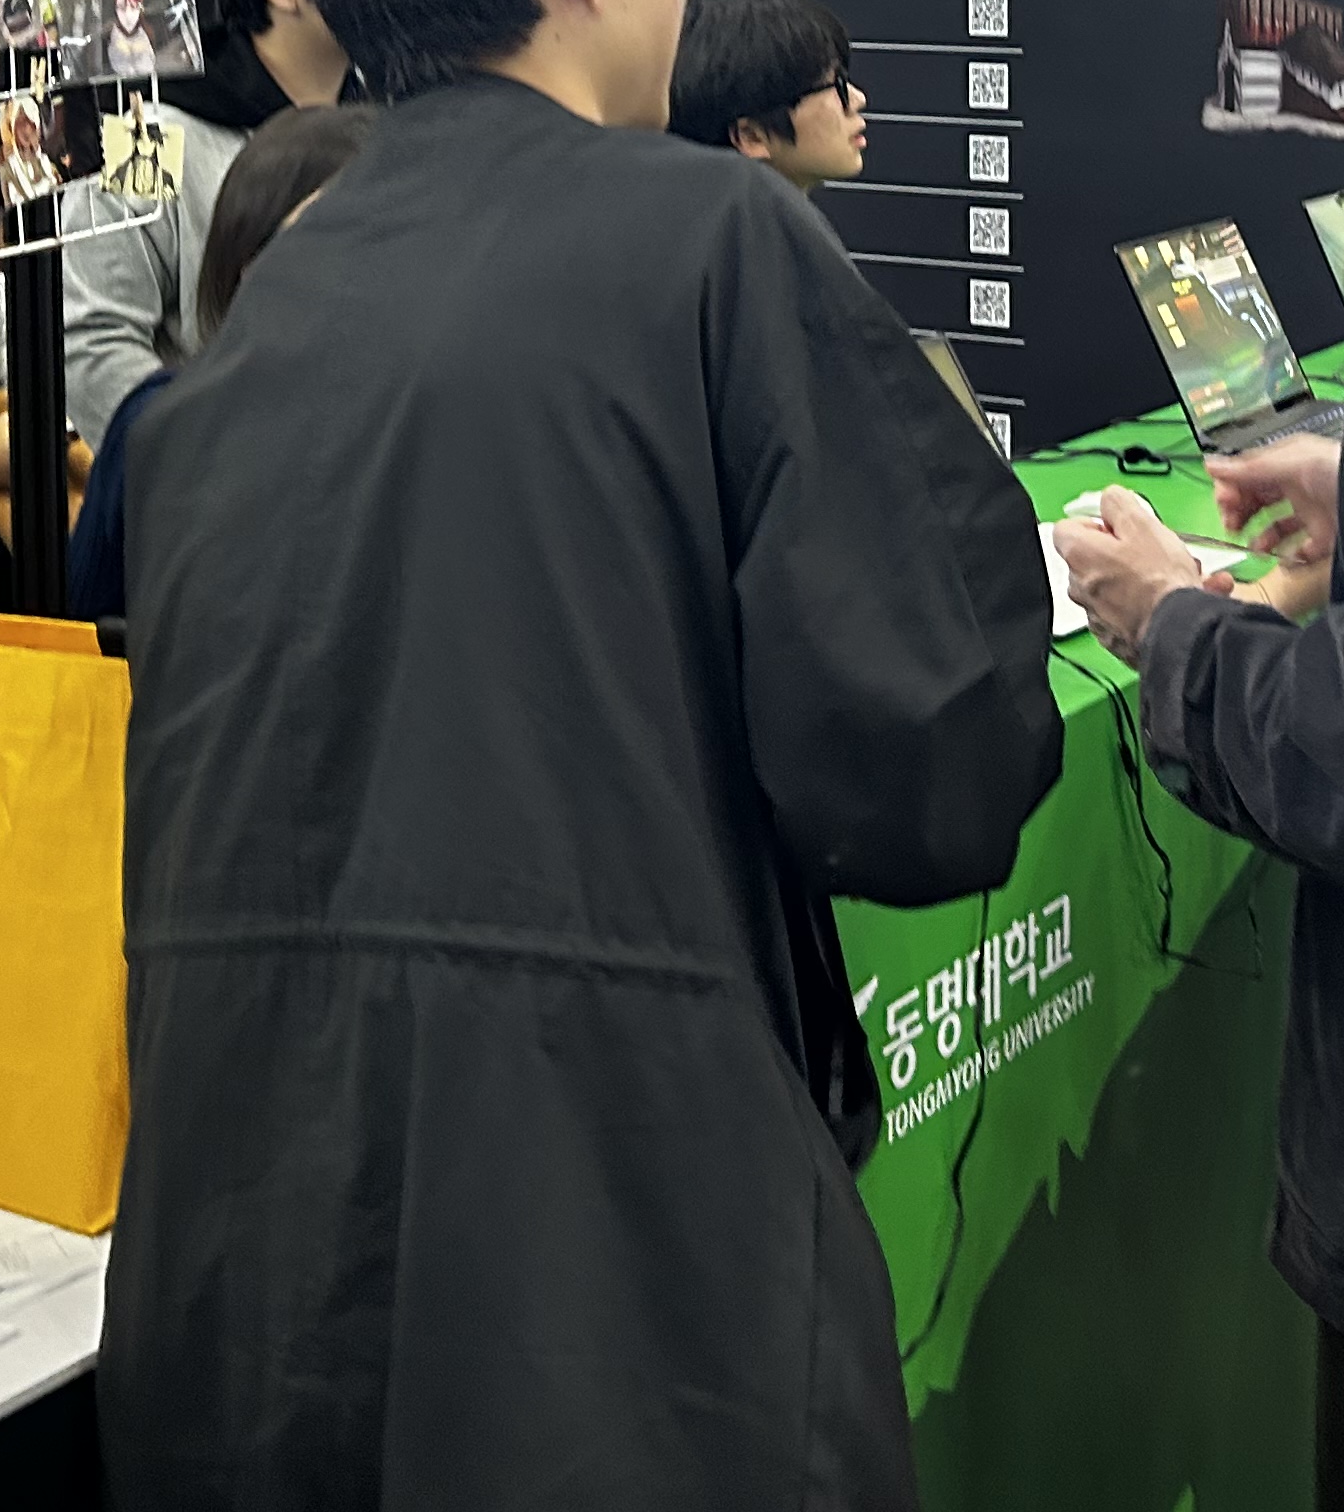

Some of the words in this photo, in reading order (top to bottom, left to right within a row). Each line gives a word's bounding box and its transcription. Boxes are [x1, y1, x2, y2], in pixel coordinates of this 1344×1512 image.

[881, 893, 1074, 1090] 동명대학교
[885, 1039, 1002, 1145] TONGMYONG
[1001, 971, 1097, 1064] UNIVERSITY
